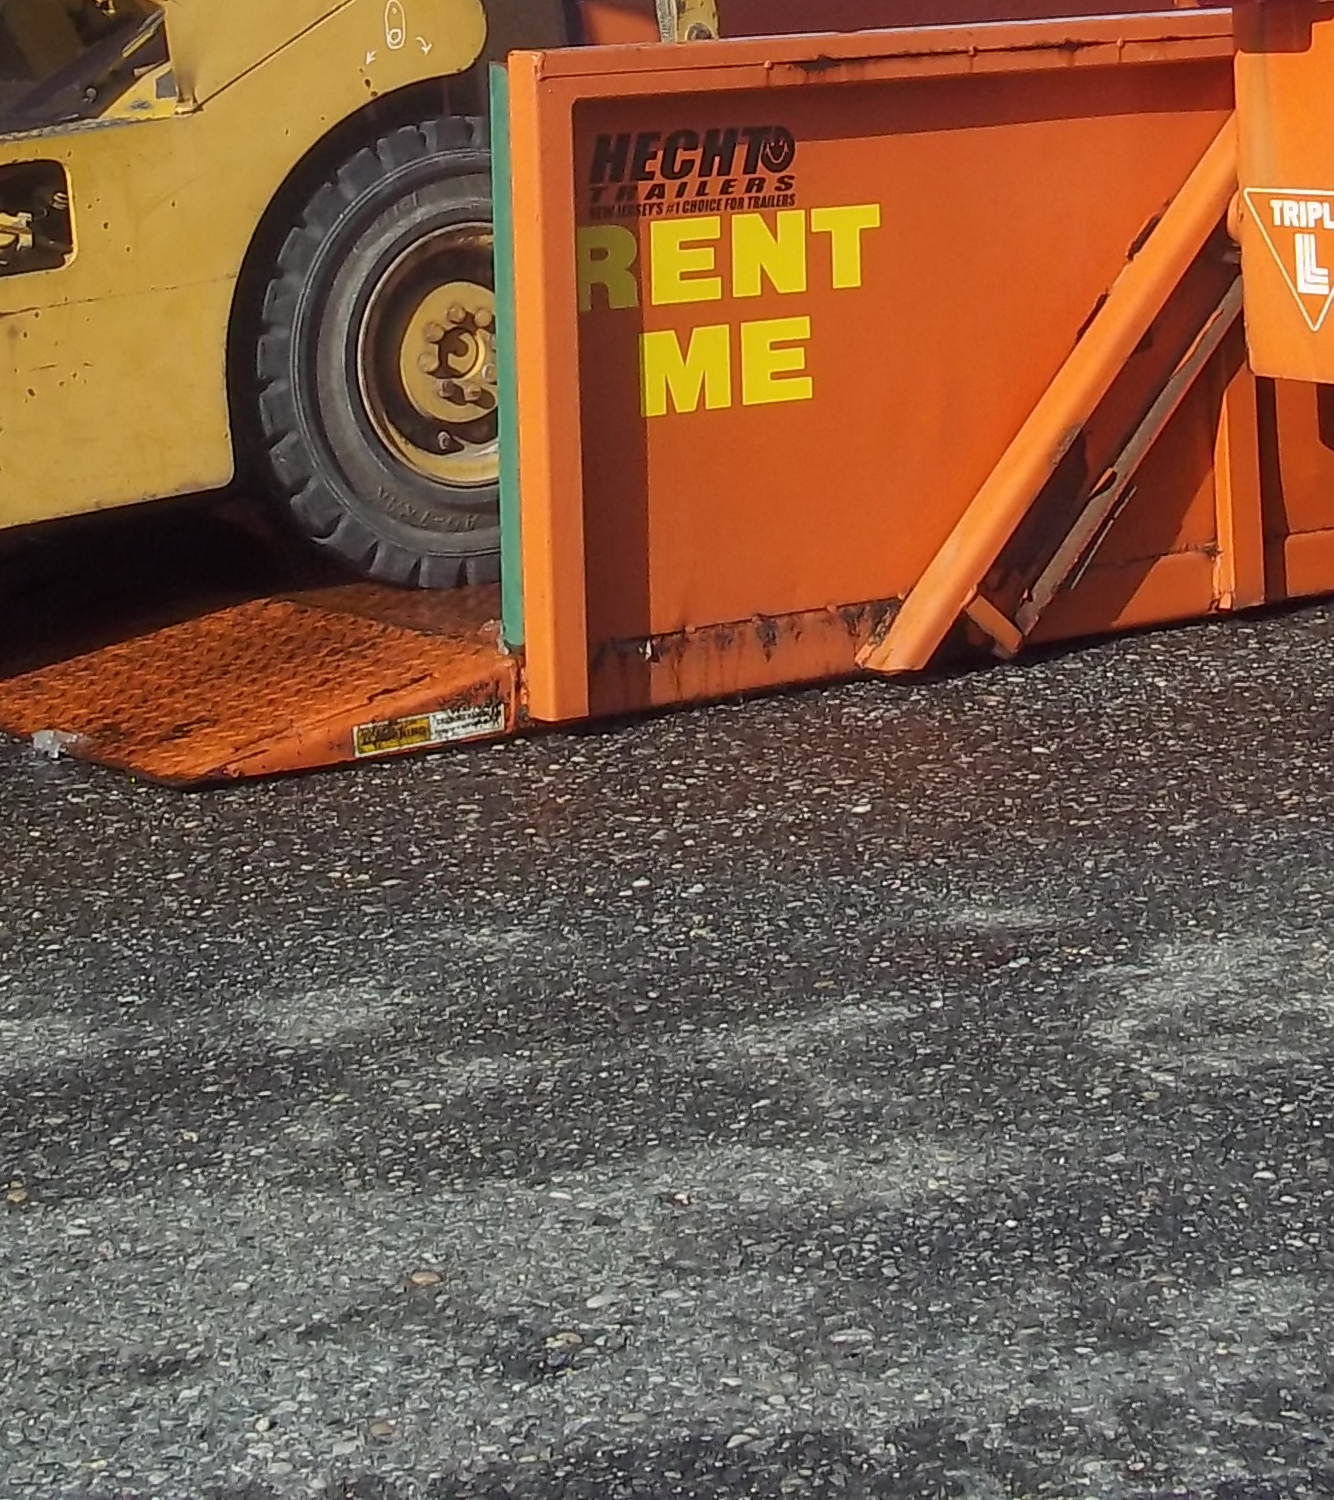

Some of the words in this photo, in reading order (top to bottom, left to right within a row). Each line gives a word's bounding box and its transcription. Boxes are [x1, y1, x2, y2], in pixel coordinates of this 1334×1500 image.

[589, 127, 765, 183] HECHT
[589, 175, 796, 204] TRAILERS
[666, 202, 680, 215] #1
[682, 199, 722, 214] CHOICE
[724, 197, 745, 211] FOR
[747, 193, 796, 209] TRAILERS
[578, 203, 880, 312] RENT
[639, 315, 813, 418] ME
